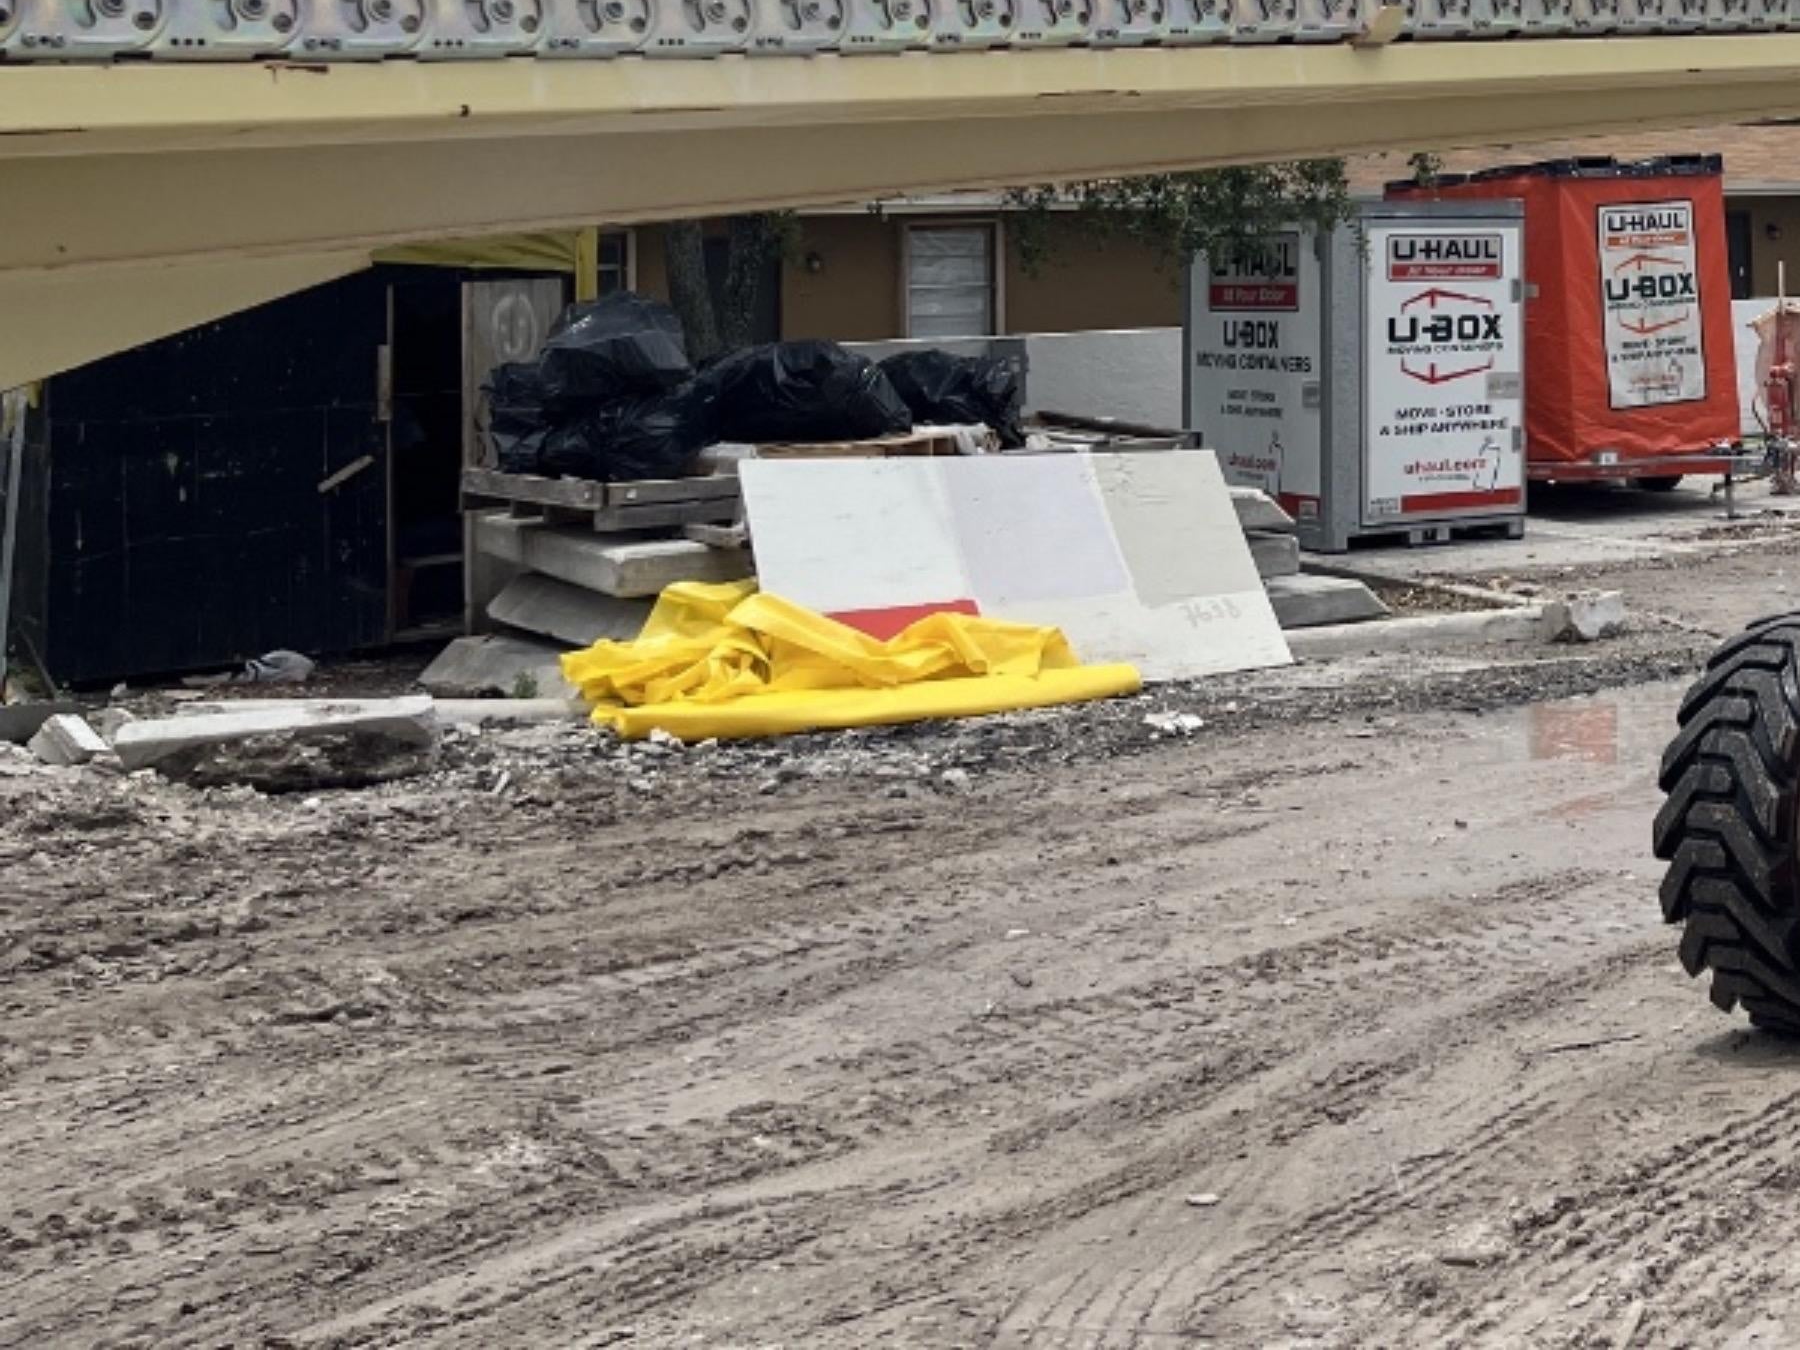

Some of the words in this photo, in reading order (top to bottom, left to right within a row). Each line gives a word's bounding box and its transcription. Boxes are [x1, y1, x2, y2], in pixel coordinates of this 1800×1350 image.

[1607, 212, 1685, 232] U-HAUL
[1393, 239, 1498, 260] U-HAUL
[1605, 272, 1696, 300] U-BOX
[1223, 320, 1279, 349] U-BOX
[1387, 314, 1503, 343] U-BOX
